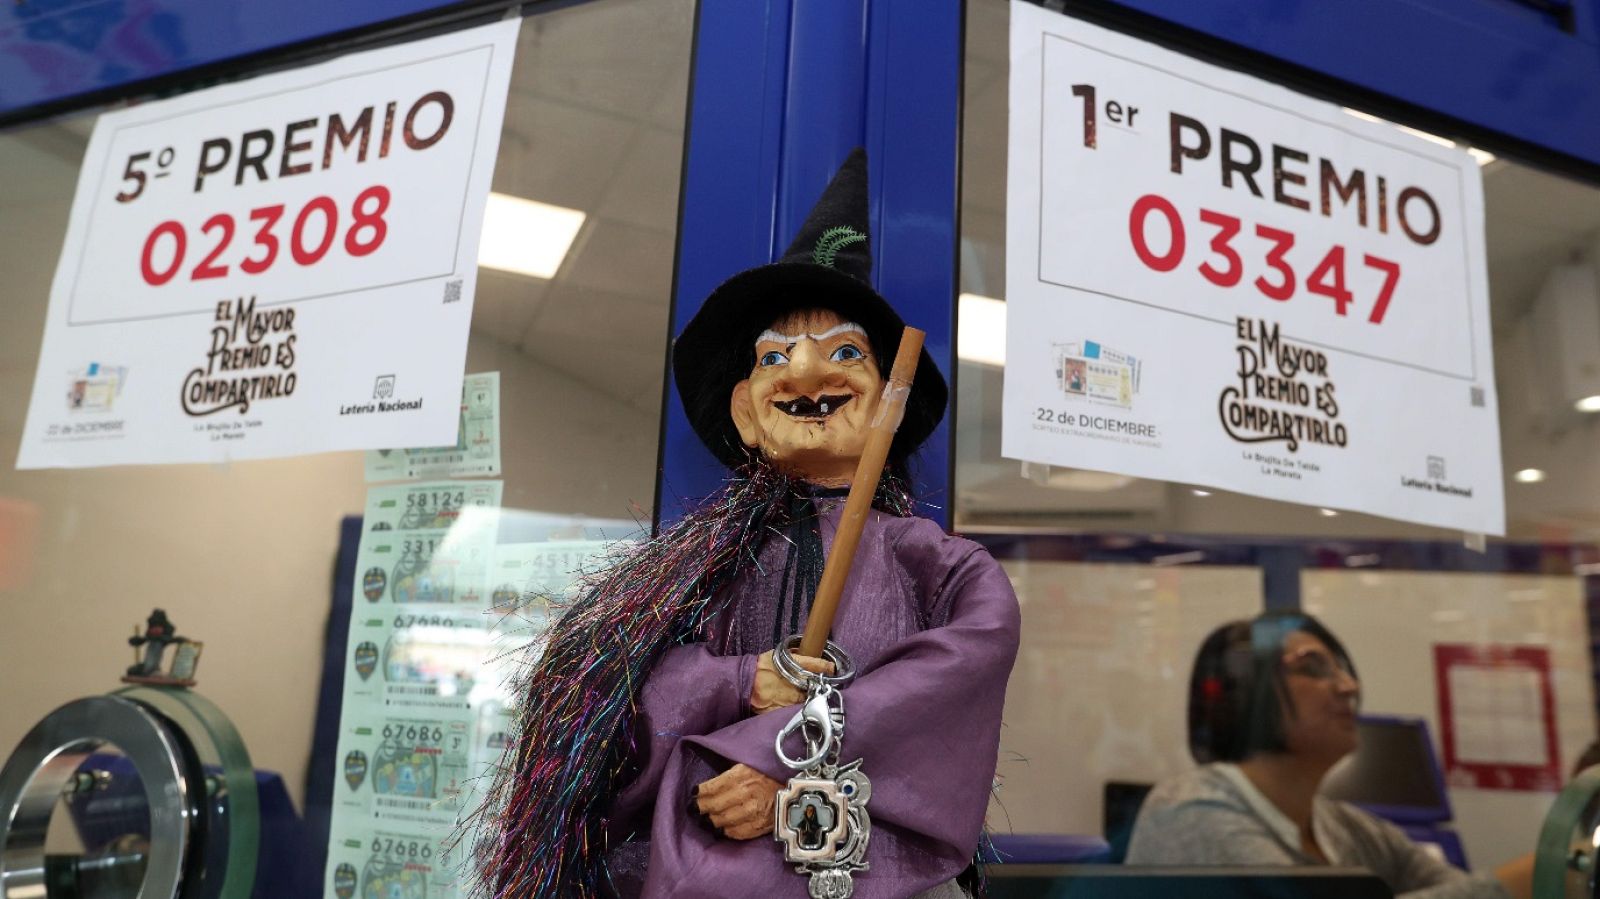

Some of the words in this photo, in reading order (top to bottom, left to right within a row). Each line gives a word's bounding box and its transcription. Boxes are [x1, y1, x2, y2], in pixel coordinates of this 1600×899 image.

[194, 91, 454, 193] PREMIO
[1071, 84, 1139, 150] 1er
[1169, 111, 1442, 247] PREMIO
[140, 185, 390, 286] 02308
[1129, 194, 1401, 325] 03347
[215, 301, 232, 321] EL
[233, 295, 295, 344] MAYOR
[207, 326, 271, 375] PREMIO
[274, 335, 296, 369] ES
[1236, 316, 1257, 342] EL
[1259, 319, 1328, 378] MAYOR
[181, 369, 296, 416] COMPARTIRLO
[376, 397, 423, 412] Nacional
[1236, 345, 1310, 407] PREMIO
[1316, 382, 1338, 418] ES
[1058, 410, 1076, 425] de
[1079, 414, 1157, 439] DICIEMBRE
[1219, 386, 1347, 453] COMPARTIRLO
[406, 491, 465, 508] 58124
[382, 724, 443, 742] 67686
[371, 837, 432, 858] 67686
